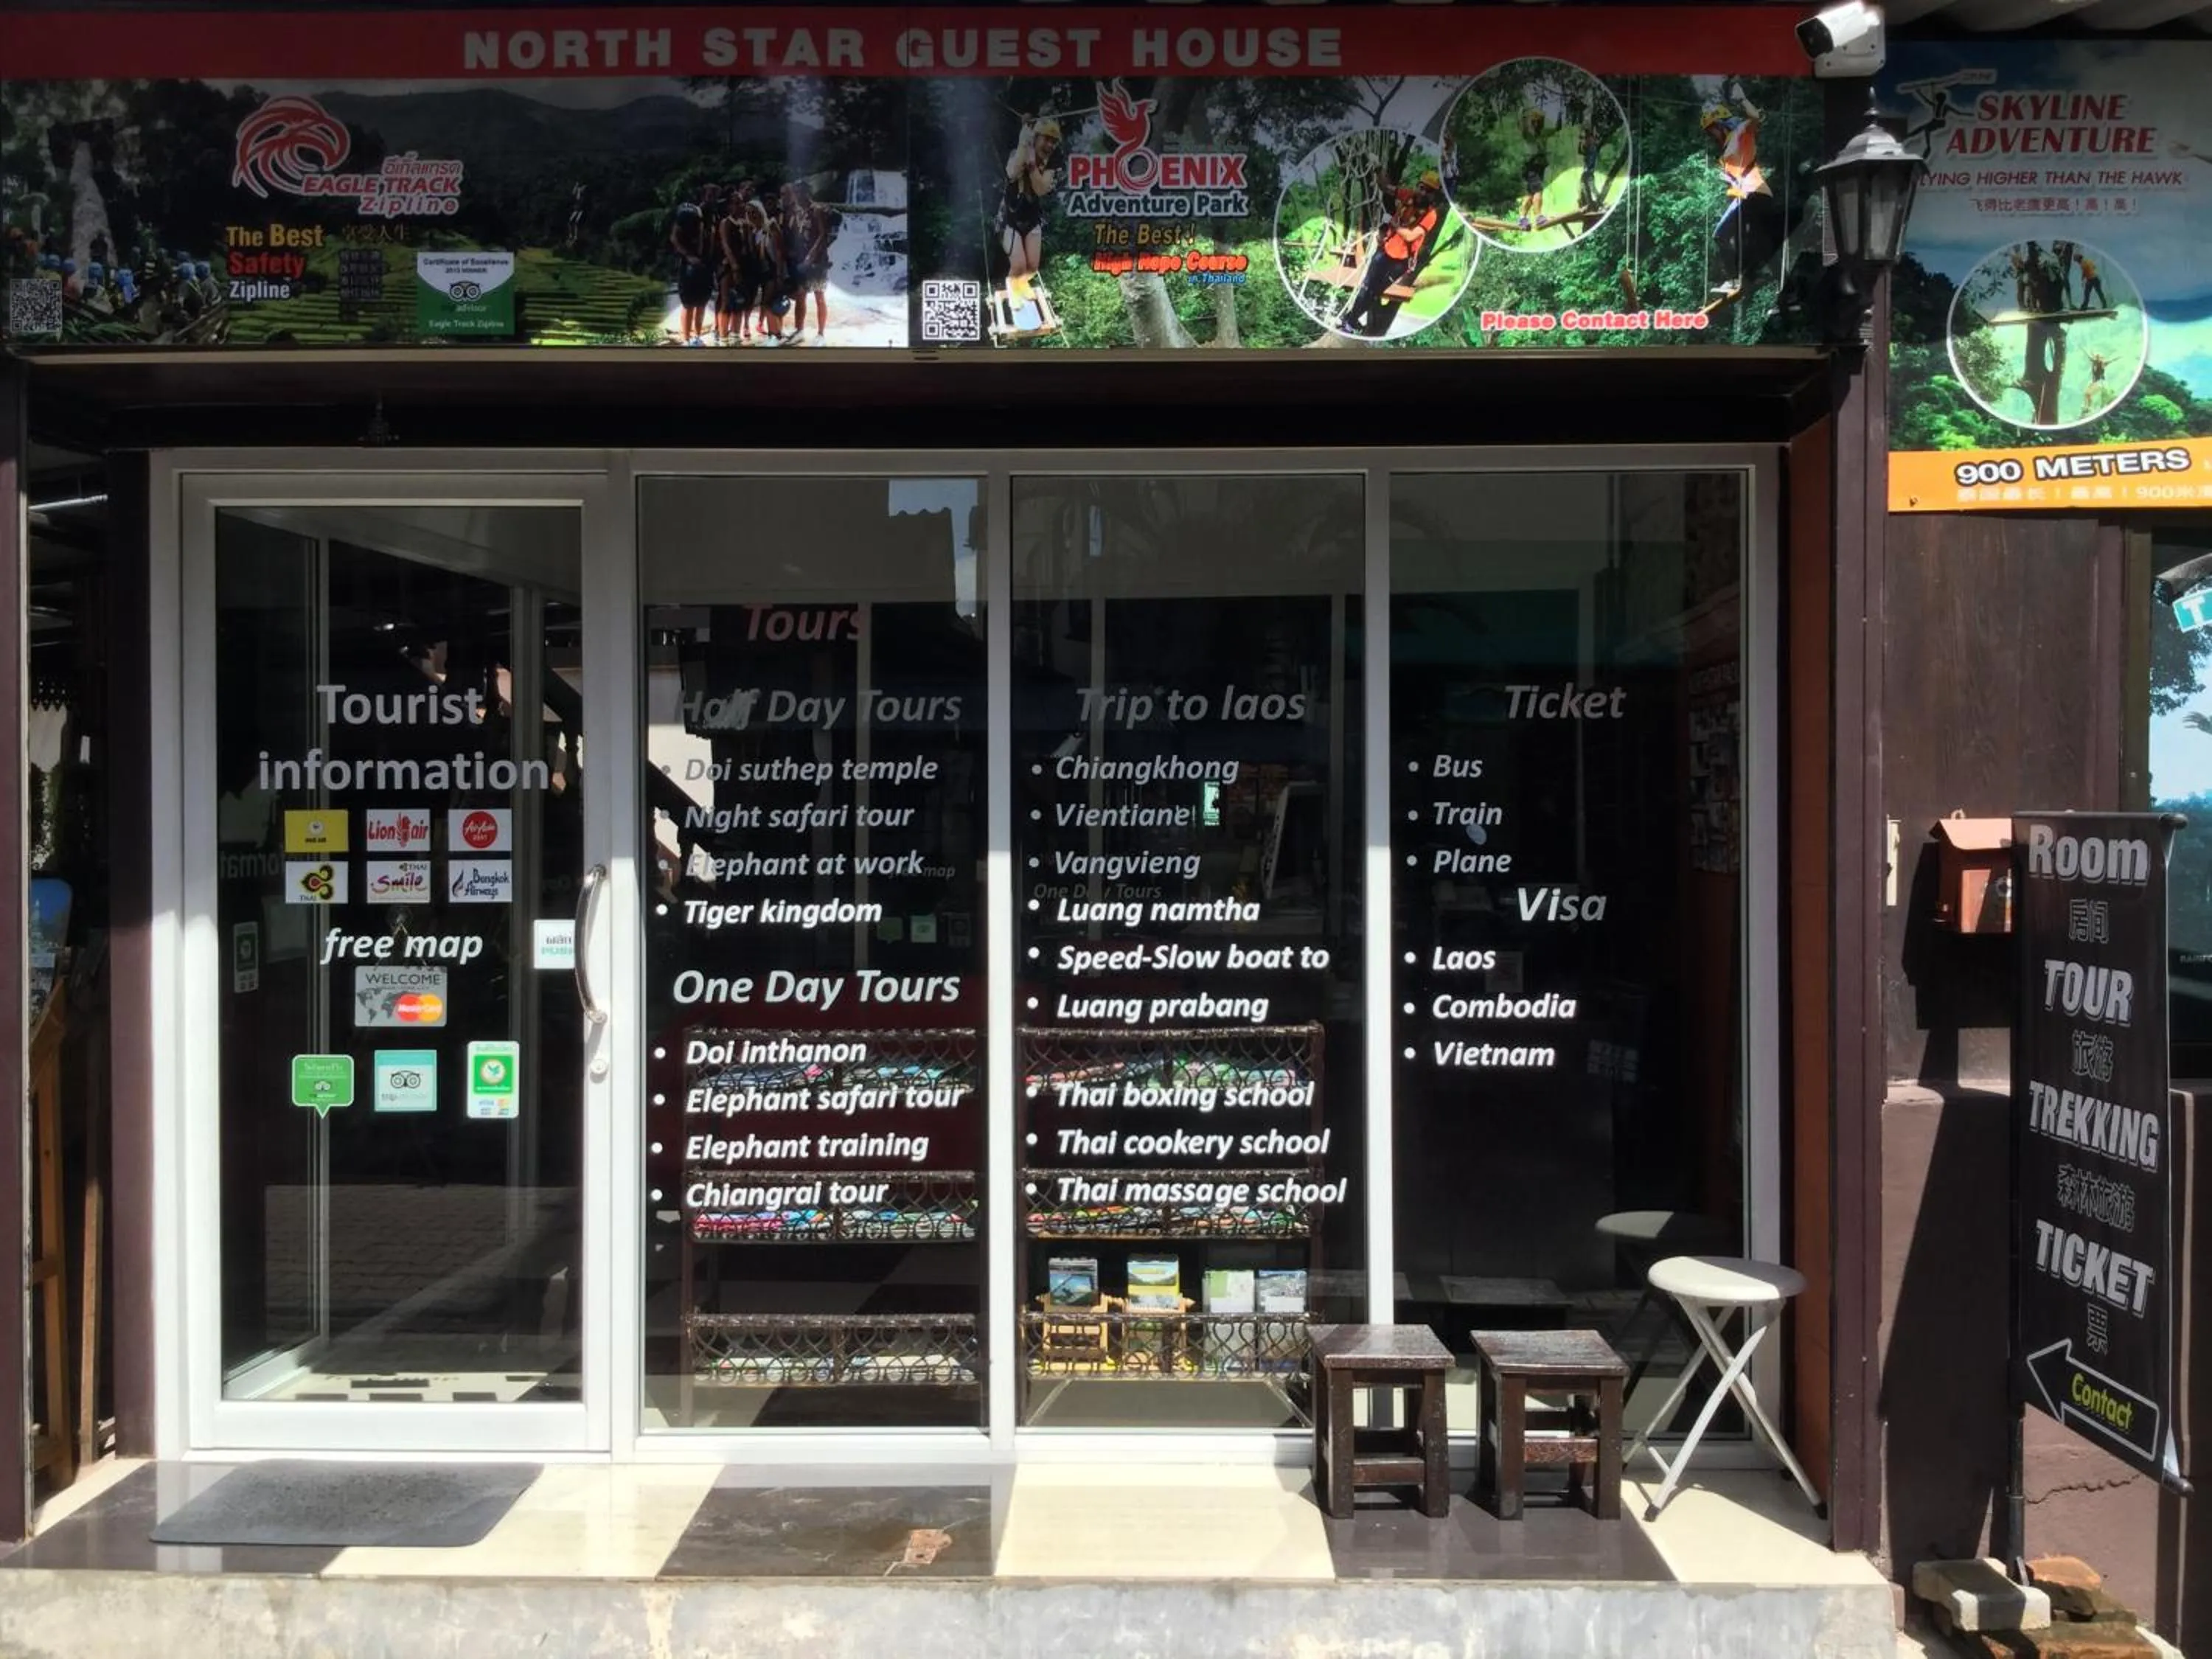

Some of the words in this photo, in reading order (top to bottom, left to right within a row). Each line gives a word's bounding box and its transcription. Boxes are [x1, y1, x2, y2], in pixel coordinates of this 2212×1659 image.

[463, 27, 672, 69] NORTH
[701, 27, 865, 68] STAR
[895, 27, 1102, 68] GUEST
[1131, 27, 1343, 68] HOUSE
[1978, 94, 2129, 122] SKYLINE
[1946, 126, 2158, 154] ADVENTURE
[303, 176, 378, 193] EAGLE
[384, 176, 459, 193] TRACK
[1070, 153, 1246, 189] PHOENIX
[1915, 171, 1971, 187] LYING
[1976, 170, 2038, 186] HIGHER
[2045, 170, 2092, 185] THAN
[2098, 170, 2125, 185] THE
[2130, 170, 2183, 186] HAWK
[362, 196, 457, 215] Zipline
[1070, 192, 1188, 214] Adventure
[1195, 192, 1246, 214] Park
[226, 226, 264, 247] The
[269, 223, 326, 247] Best
[1095, 223, 1130, 245] The
[228, 251, 305, 279] Safety
[1186, 250, 1248, 272] Course
[229, 279, 292, 302] Zipline
[1481, 310, 1557, 332] Please
[1561, 310, 1648, 332] Contact
[1654, 310, 1709, 331] Here
[1955, 458, 2024, 487] 900
[2032, 448, 2192, 481] METERS
[317, 684, 484, 726] Tourist
[767, 689, 846, 731] Day
[858, 688, 963, 723] Tours
[1076, 686, 1154, 731] Trip
[1167, 689, 1208, 721] to
[1221, 684, 1307, 722] laos
[1504, 682, 1627, 720] Ticket
[259, 748, 550, 790] information
[685, 758, 731, 781] Doi
[738, 757, 835, 787] suthep
[841, 754, 939, 787] temple
[1055, 754, 1240, 785] Chiangkhong
[1432, 754, 1484, 779] Bus
[684, 805, 761, 834] Night
[768, 801, 849, 832] safari
[856, 805, 915, 827] tour
[1055, 802, 1191, 827] Vientiane
[1432, 801, 1503, 827] Train
[368, 819, 395, 841] Lion
[411, 819, 429, 841] air
[686, 851, 810, 881] Elephant
[817, 853, 848, 877] at
[855, 849, 925, 877] work
[1054, 849, 1202, 880] Vangvieng
[1432, 849, 1512, 874] Plane
[2028, 824, 2151, 886] Room
[371, 872, 428, 894] Smile
[684, 900, 754, 929] Tiger
[759, 897, 883, 929] kingdom
[1057, 897, 1144, 928] Luang
[1150, 895, 1261, 923] namtha
[1516, 886, 1607, 922] Visa
[319, 927, 395, 965] free
[404, 933, 484, 966] map
[1057, 942, 1221, 975] Speed-Slow
[1227, 943, 1293, 970] boat
[1300, 946, 1331, 970] to
[1432, 946, 1497, 971] Laos
[365, 973, 442, 985] WELCOME
[672, 970, 754, 1004] One
[765, 970, 844, 1011] Day
[855, 968, 961, 1004] Tours
[2044, 958, 2135, 1027] TOUR
[1057, 993, 1142, 1024] Luang
[1149, 992, 1270, 1023] prabang
[1432, 992, 1579, 1019] Combodia
[686, 1040, 735, 1065] Doi
[740, 1037, 867, 1065] inthanon
[1433, 1040, 1556, 1068] Vietnam
[685, 1087, 810, 1118] Elephant
[817, 1083, 898, 1115] safari
[905, 1085, 967, 1108] tour
[1056, 1082, 1116, 1108] Thai
[1122, 1081, 1217, 1113] boxing
[1223, 1080, 1316, 1108] school
[2028, 1079, 2161, 1174] TREKKING
[685, 1133, 810, 1165] Elephant
[817, 1132, 930, 1162] training
[1057, 1128, 1116, 1155] Thai
[1123, 1127, 1234, 1160] cookery
[1239, 1128, 1332, 1155] school
[685, 1180, 822, 1211] Chiangrai
[829, 1182, 891, 1203] tour
[1057, 1177, 1117, 1204] Thai
[1124, 1182, 1249, 1207] massage
[1256, 1176, 1349, 1204] school
[2034, 1218, 2154, 1319] TICKET
[2070, 1372, 2135, 1433] Contact
